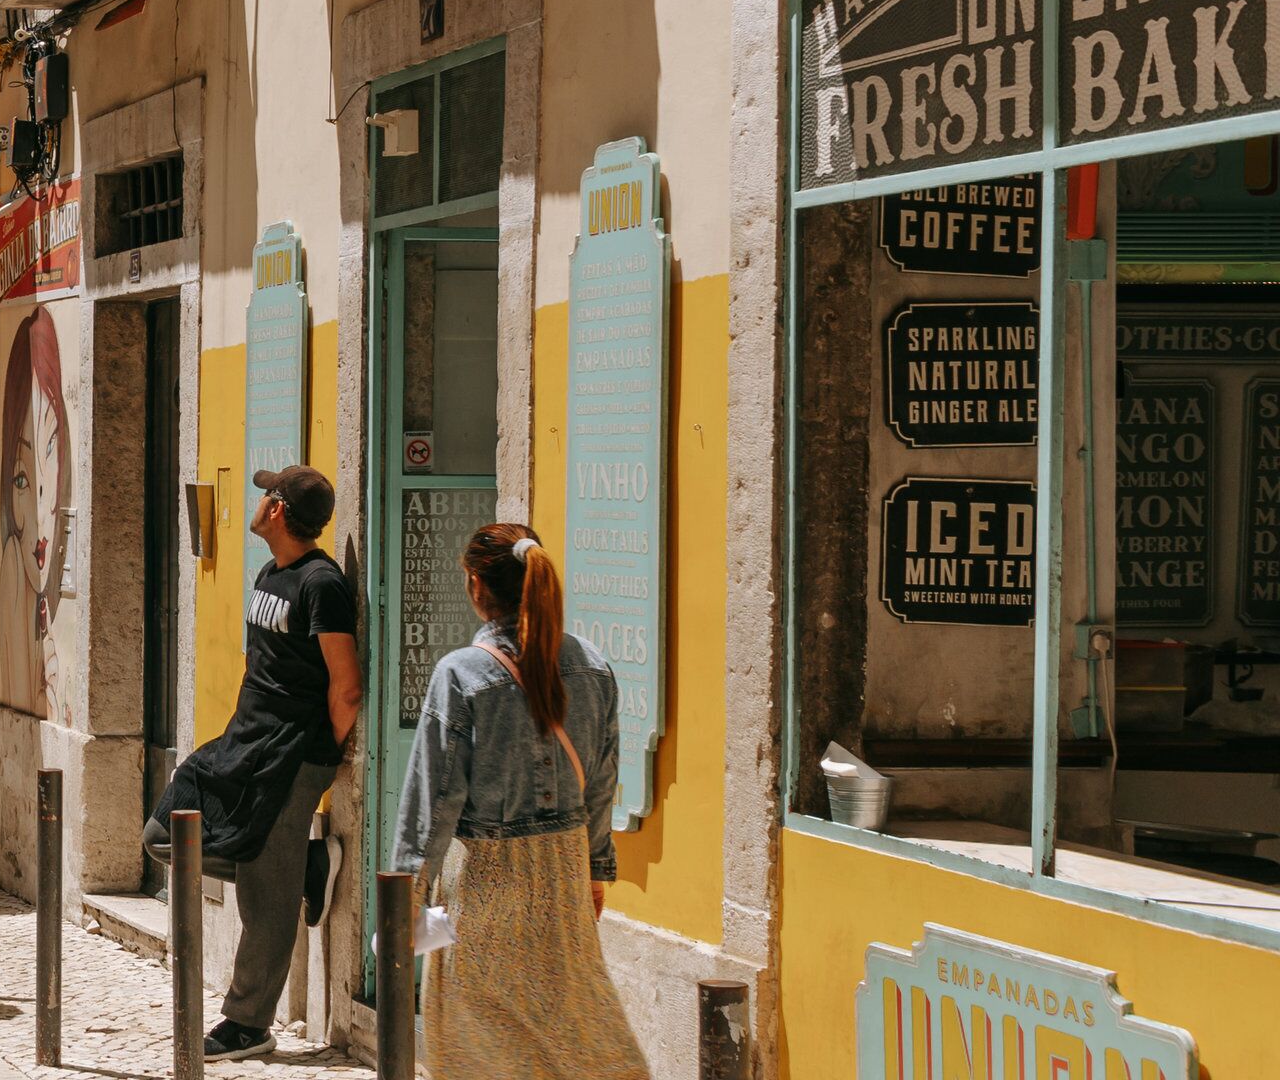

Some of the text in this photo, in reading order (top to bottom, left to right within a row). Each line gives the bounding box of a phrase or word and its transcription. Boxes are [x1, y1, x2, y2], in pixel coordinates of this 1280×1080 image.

[815, 39, 1035, 178] FRESH
[588, 180, 642, 236] UNION
[957, 184, 1035, 208] BREWED
[43, 200, 80, 254] BAIRRO
[899, 209, 1035, 255] COFFEE
[256, 248, 292, 290] UNION
[908, 326, 1037, 352] SPARKLING
[576, 345, 652, 373] EMPANADAS
[909, 359, 1037, 391] NATURAL
[909, 400, 1038, 424] GINGER ALE
[575, 462, 649, 503] VINHO
[404, 517, 468, 532] TODOS
[906, 500, 1034, 556] ICED
[404, 548, 432, 558] ESTE
[405, 533, 445, 549] DAS
[574, 527, 649, 555] COCKTAILS
[405, 572, 425, 585] DE
[573, 571, 648, 600] SMOOTHIES
[905, 557, 1032, 589] MINT TEA
[403, 593, 424, 601] RUA
[904, 591, 1033, 607] SWEETENED WITH HONEY
[572, 619, 648, 665] DOCES
[936, 957, 1096, 1027] EMPANADAS
